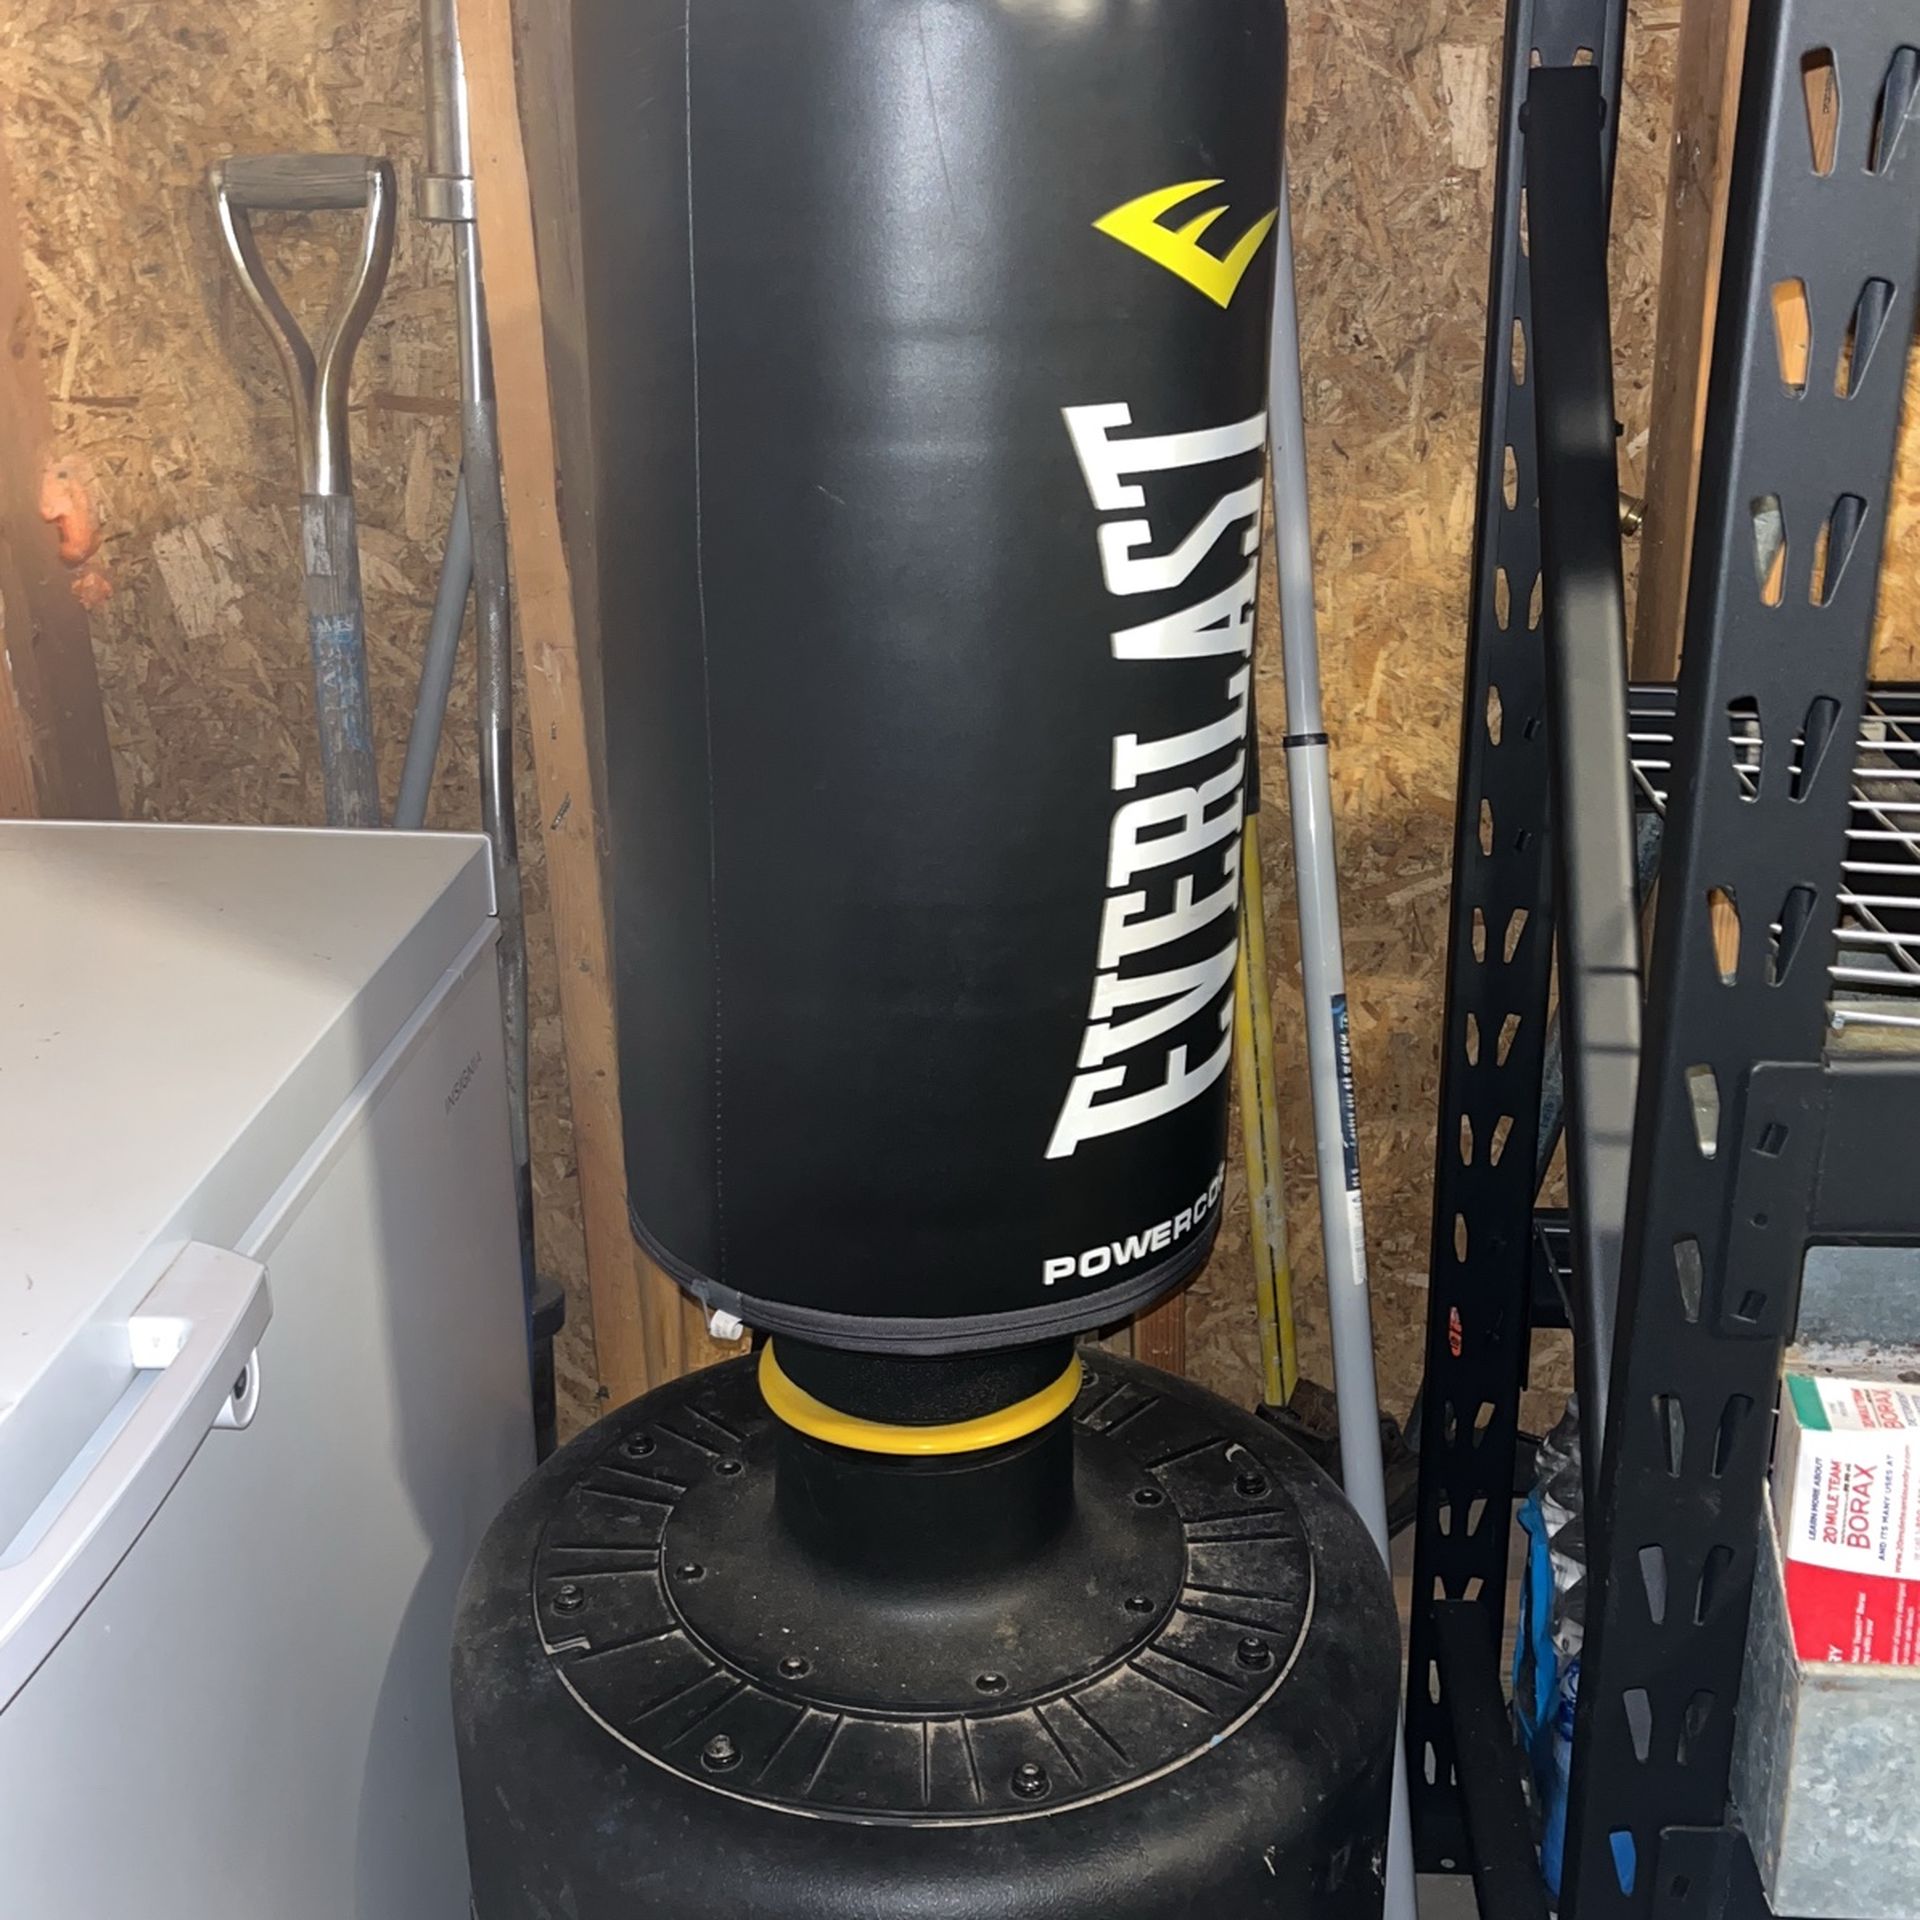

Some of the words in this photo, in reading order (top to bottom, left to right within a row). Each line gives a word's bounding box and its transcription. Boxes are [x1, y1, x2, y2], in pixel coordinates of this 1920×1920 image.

[1043, 402, 1268, 1160] EVERLAST
[1871, 1388, 1905, 1429] BORAX
[1814, 1457, 1823, 1486] ABOUT
[1886, 1454, 1894, 1467] AT
[1828, 1460, 1841, 1491] TEAM
[1885, 1470, 1893, 1494] USES
[1811, 1488, 1821, 1512] MORE
[1825, 1494, 1839, 1525] MULE
[1847, 1463, 1878, 1549] BORAX
[1882, 1496, 1890, 1523] MANY
[1809, 1512, 1818, 1540] LEARN
[1823, 1526, 1838, 1544] 20
[1878, 1542, 1887, 1561] AND
